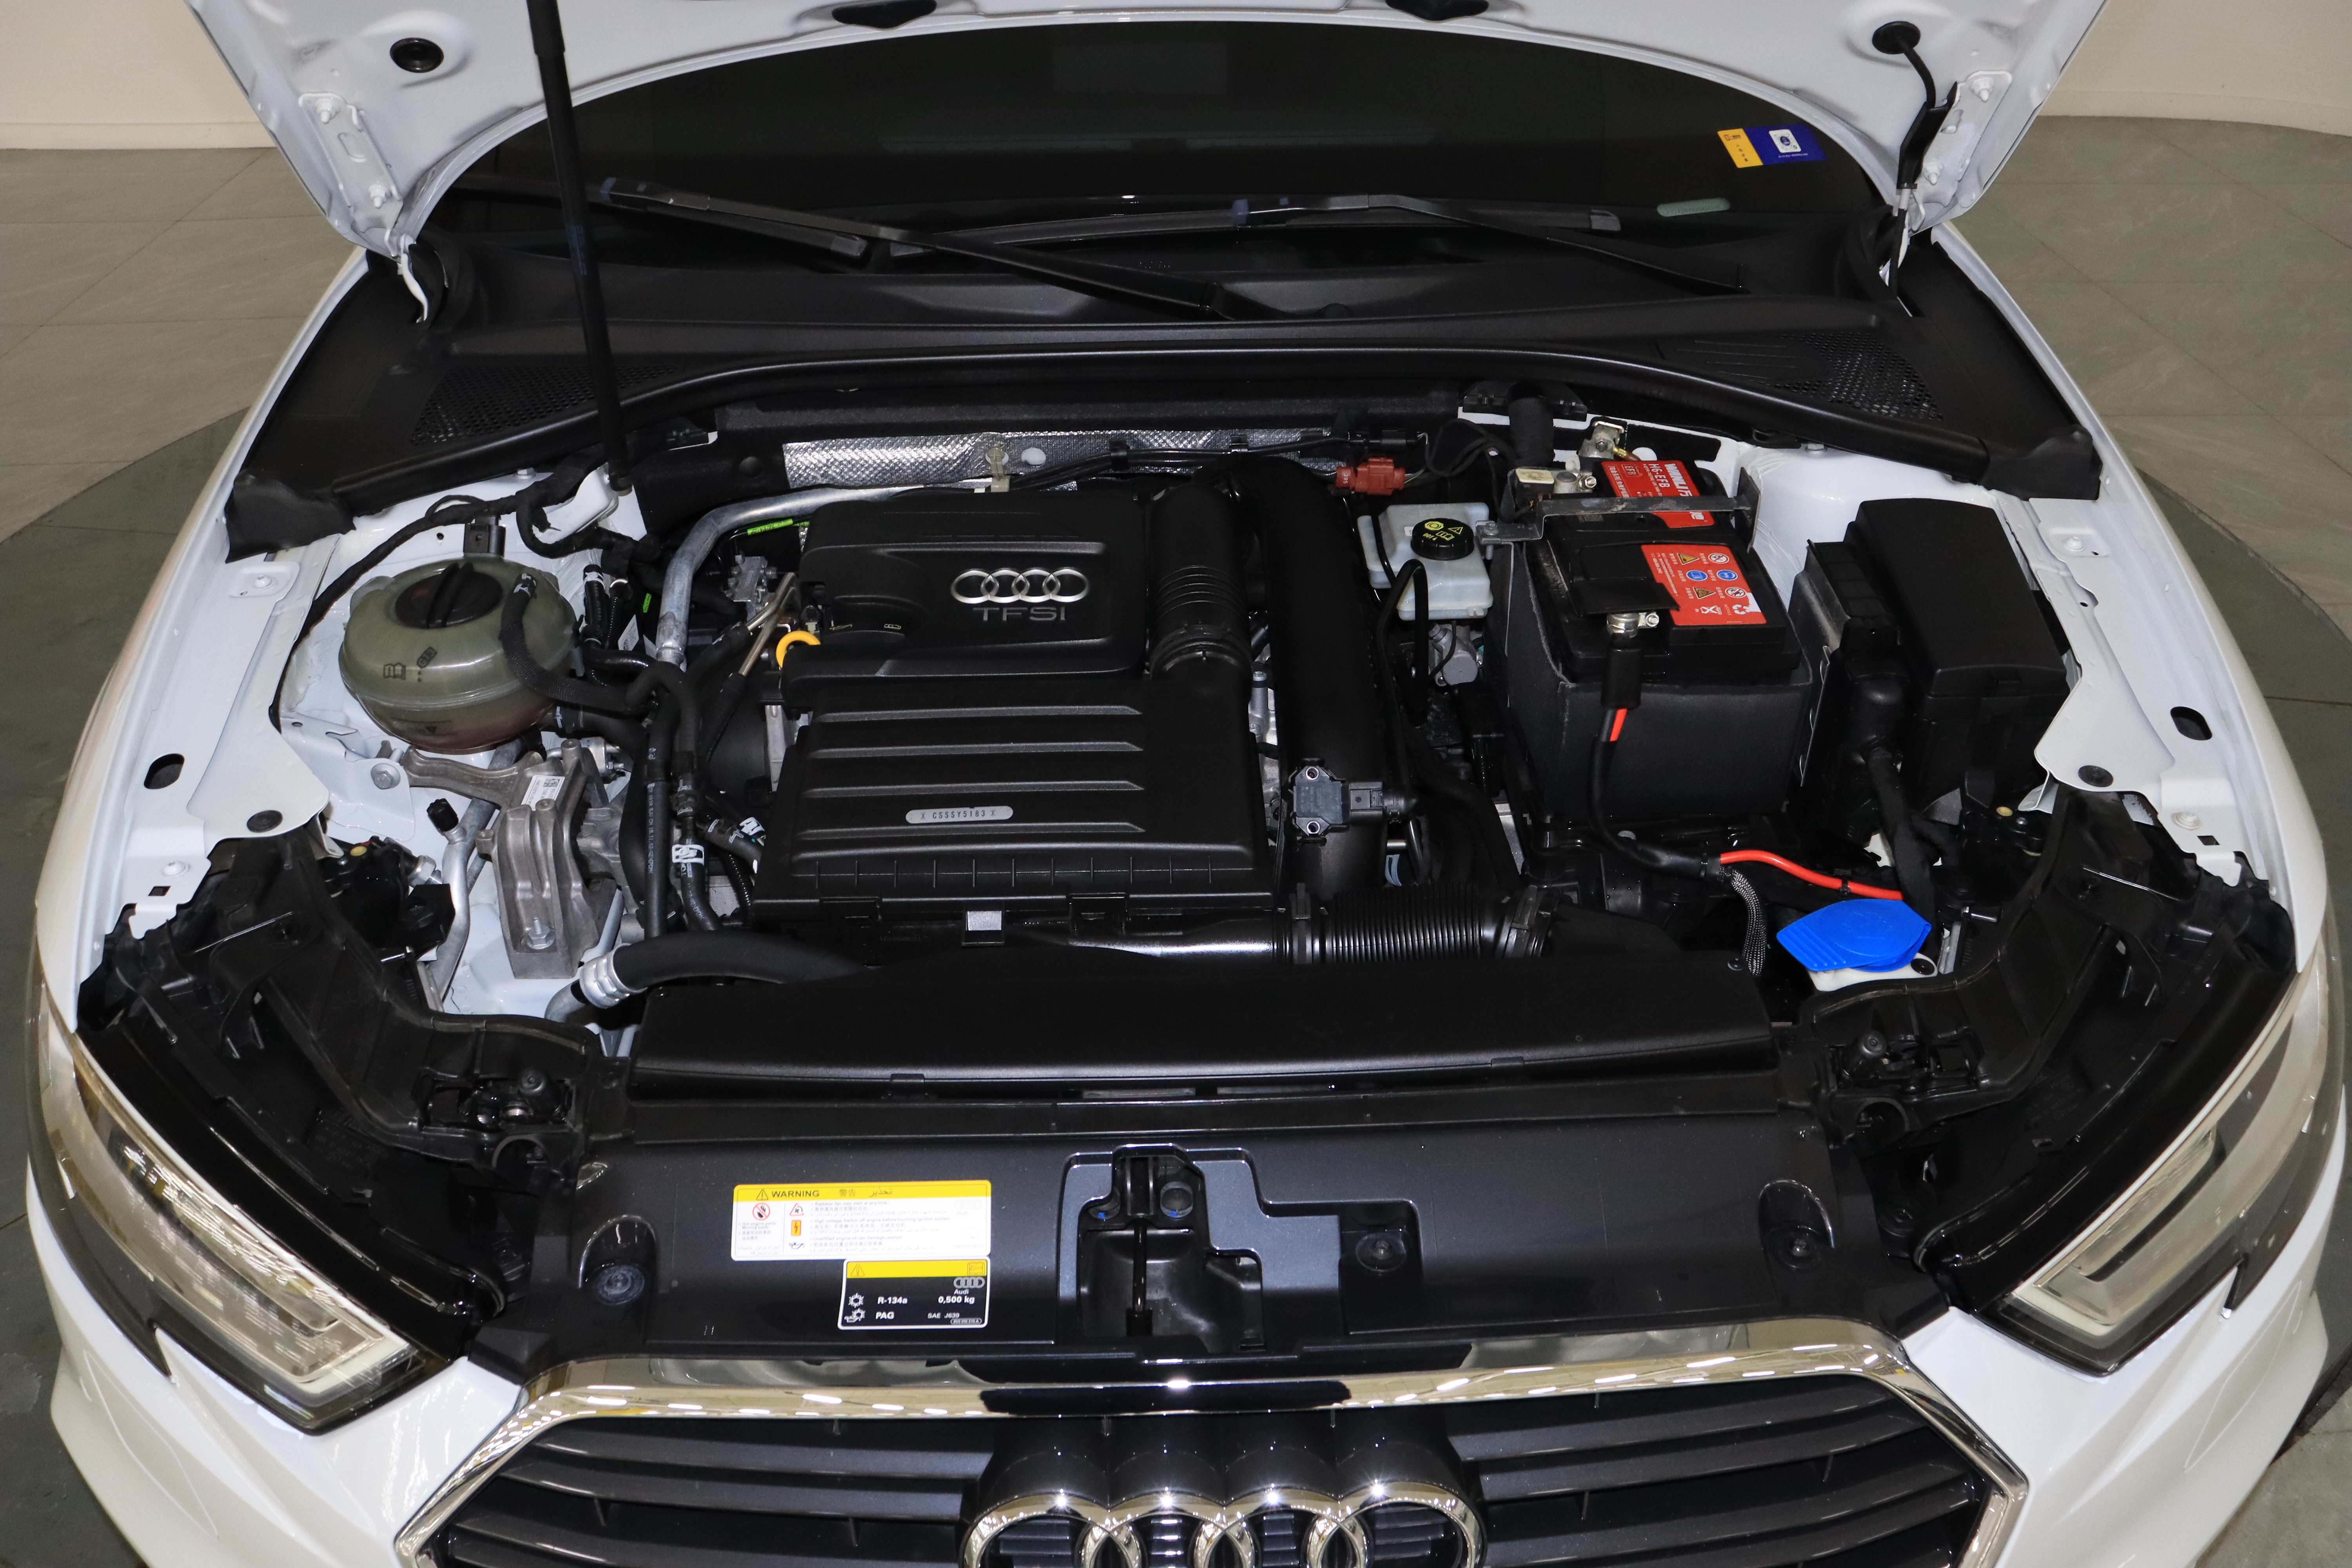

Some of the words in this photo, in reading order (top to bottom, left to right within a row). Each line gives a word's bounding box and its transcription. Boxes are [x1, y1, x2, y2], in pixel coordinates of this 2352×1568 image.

[1624, 465, 1637, 475] EFB
[1648, 463, 1671, 488] H6-EFB
[1664, 463, 1689, 490] WANLI
[973, 606, 1065, 622] TFSI
[418, 649, 435, 666] G13
[839, 1189, 856, 1197] 警告
[877, 1296, 908, 1304] R-134a
[938, 1296, 962, 1305] 0,500
[964, 1296, 975, 1304] kg
